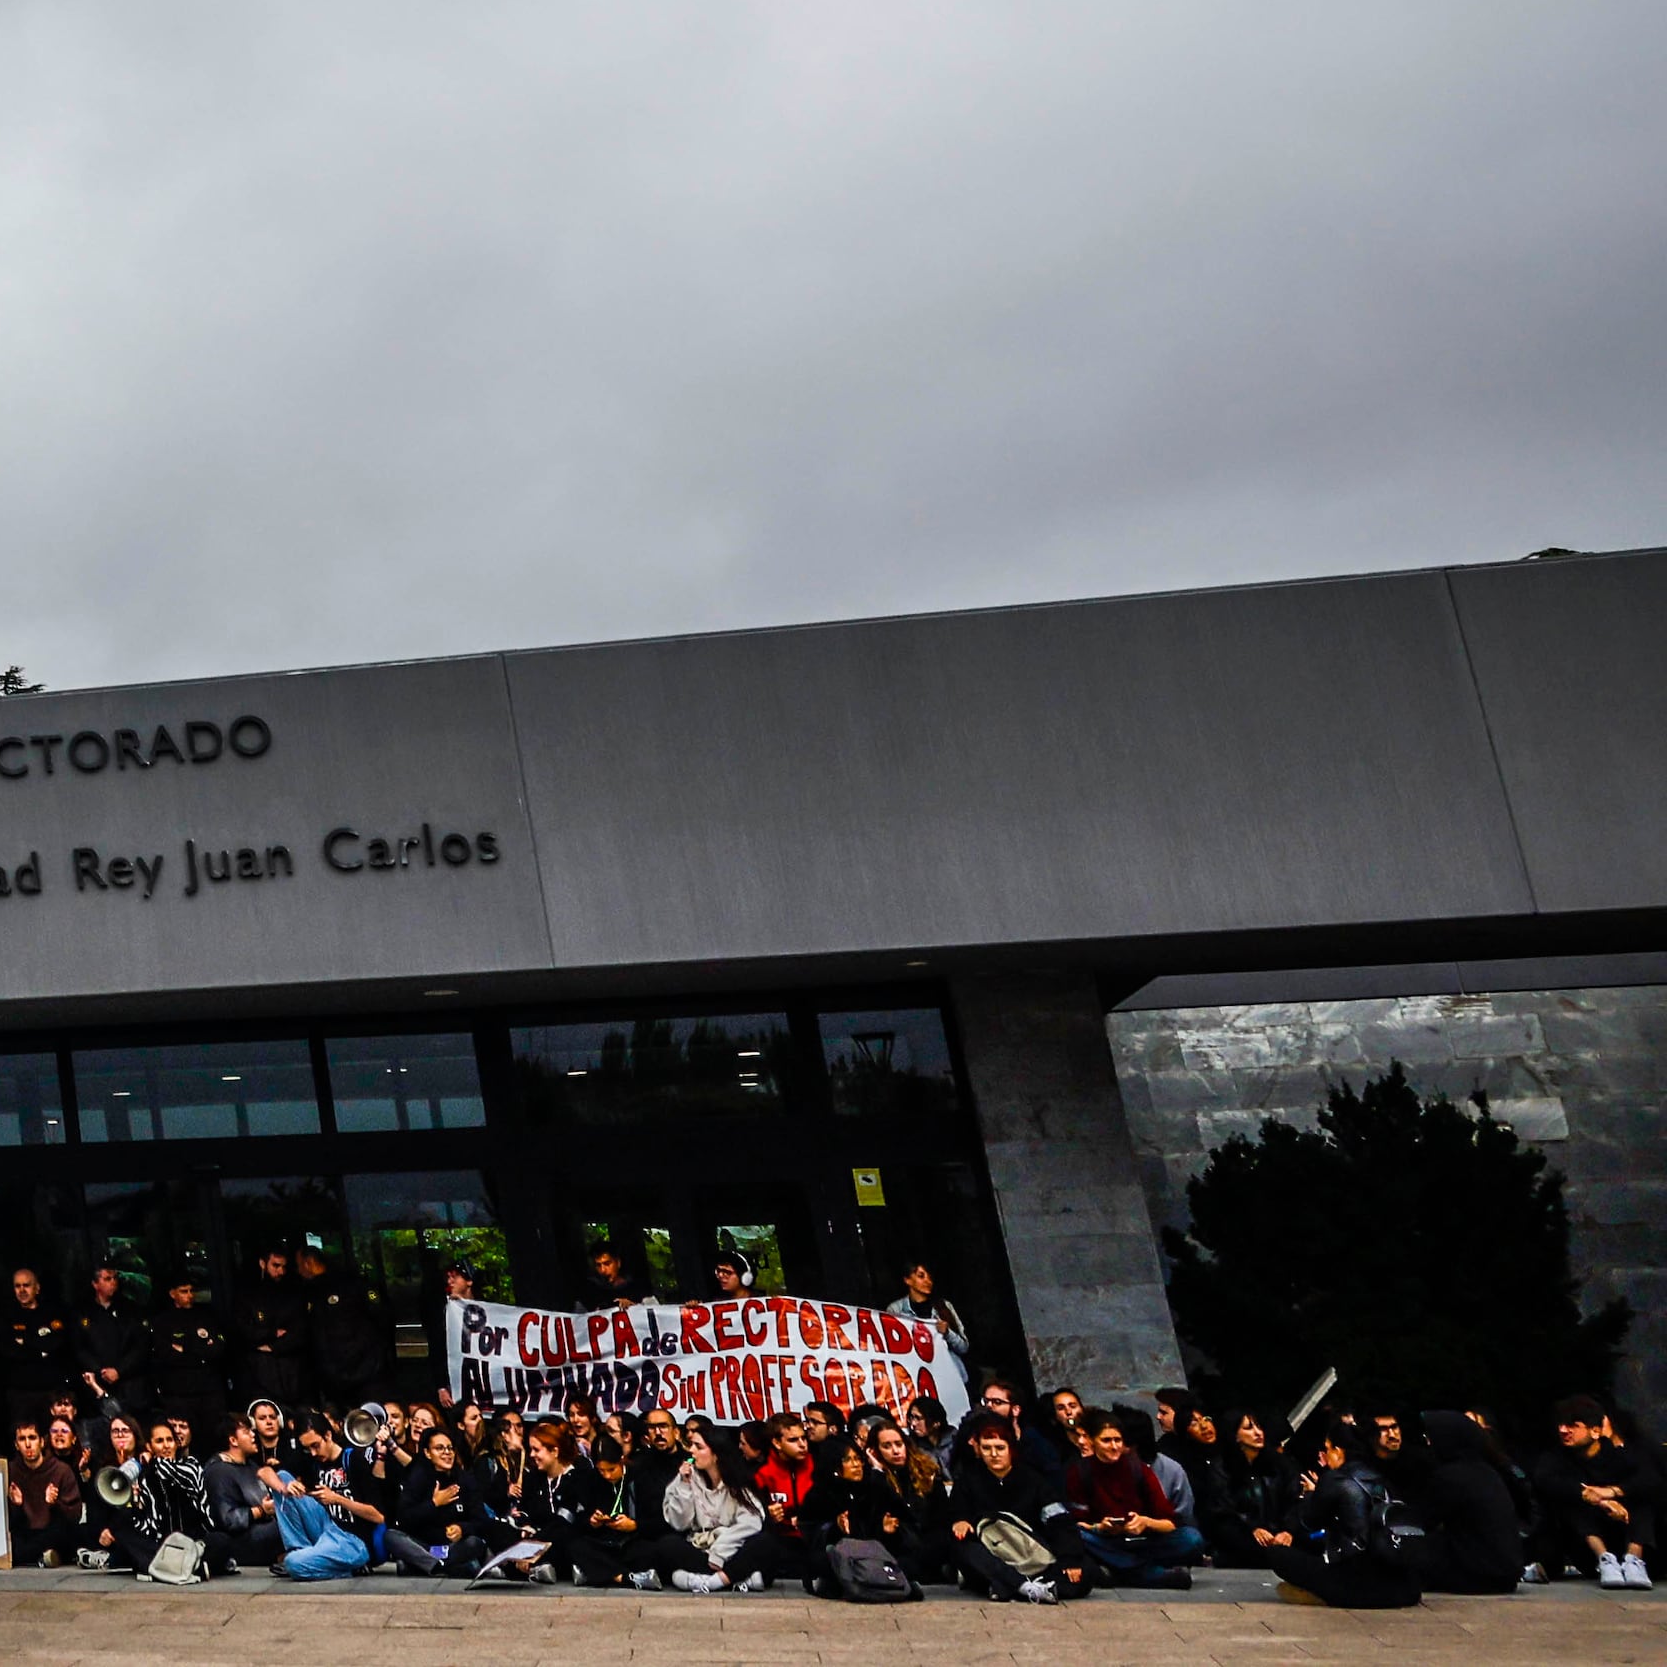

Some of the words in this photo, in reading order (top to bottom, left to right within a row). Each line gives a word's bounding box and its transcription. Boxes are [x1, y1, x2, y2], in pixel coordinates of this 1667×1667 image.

[72, 847, 165, 899] Rey
[184, 838, 294, 897] Juan
[323, 822, 501, 873] Carlos
[461, 1303, 509, 1356] Por
[517, 1309, 641, 1368] CULPA
[642, 1308, 679, 1357] de
[679, 1296, 935, 1364] RECTORADO
